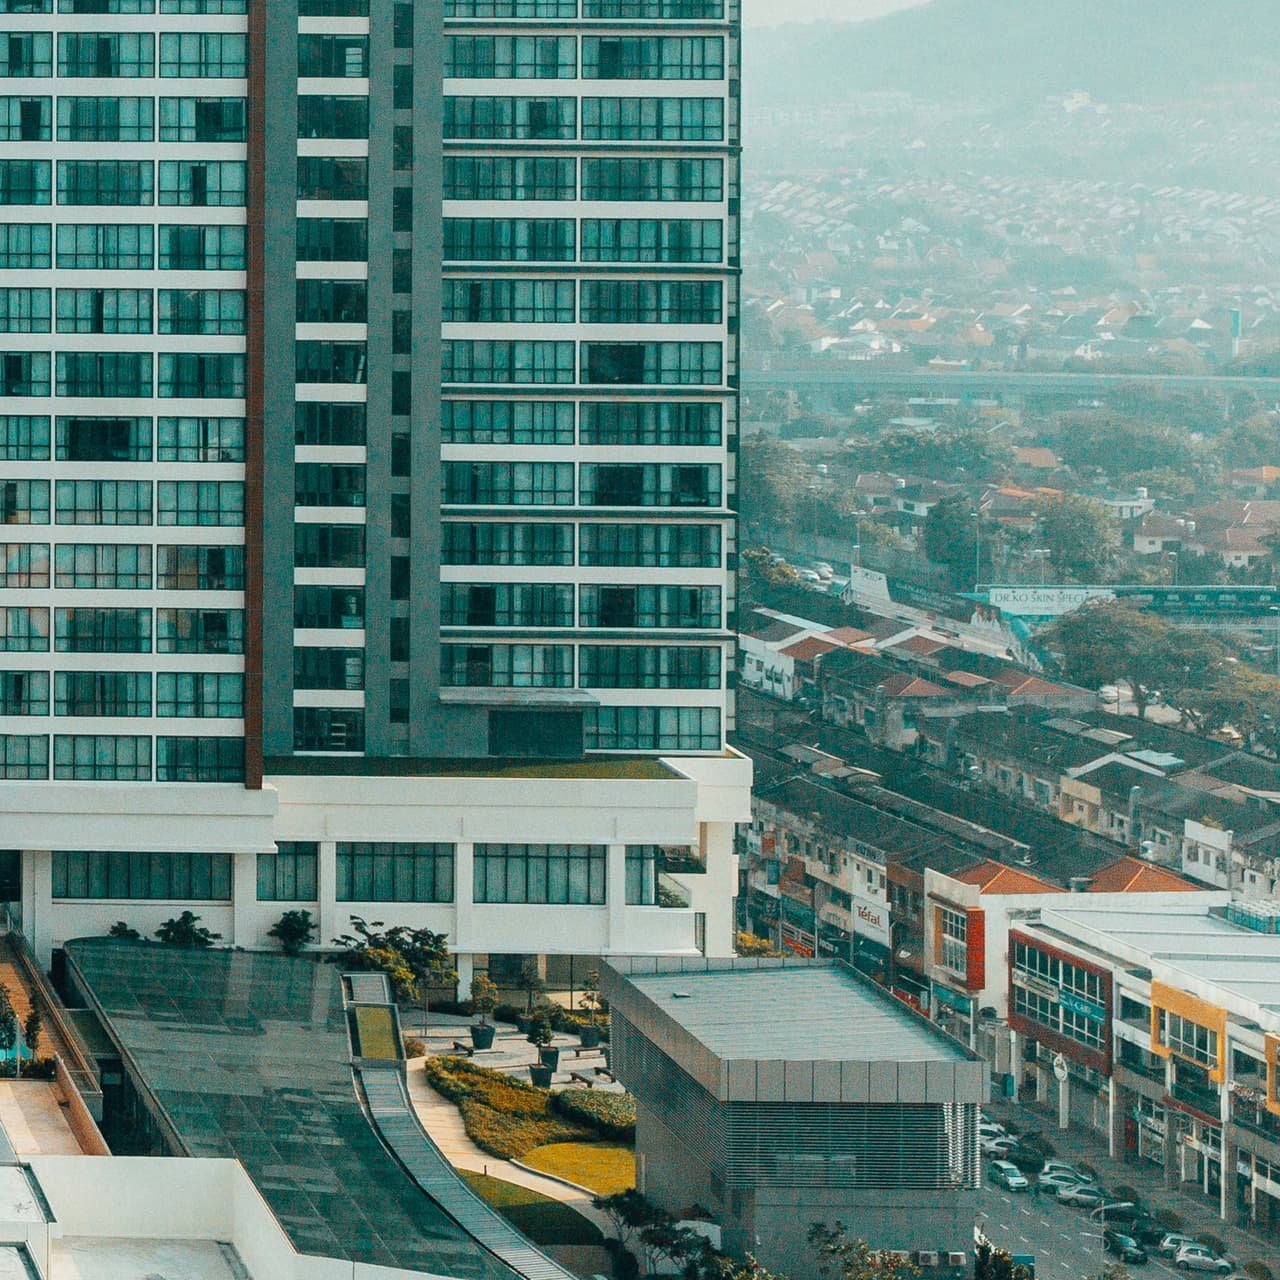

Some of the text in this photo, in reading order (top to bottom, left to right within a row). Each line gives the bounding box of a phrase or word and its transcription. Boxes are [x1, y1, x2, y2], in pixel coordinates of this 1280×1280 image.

[994, 593, 1010, 602] DR
[1012, 593, 1029, 602] KO
[1031, 593, 1054, 602] SKIN
